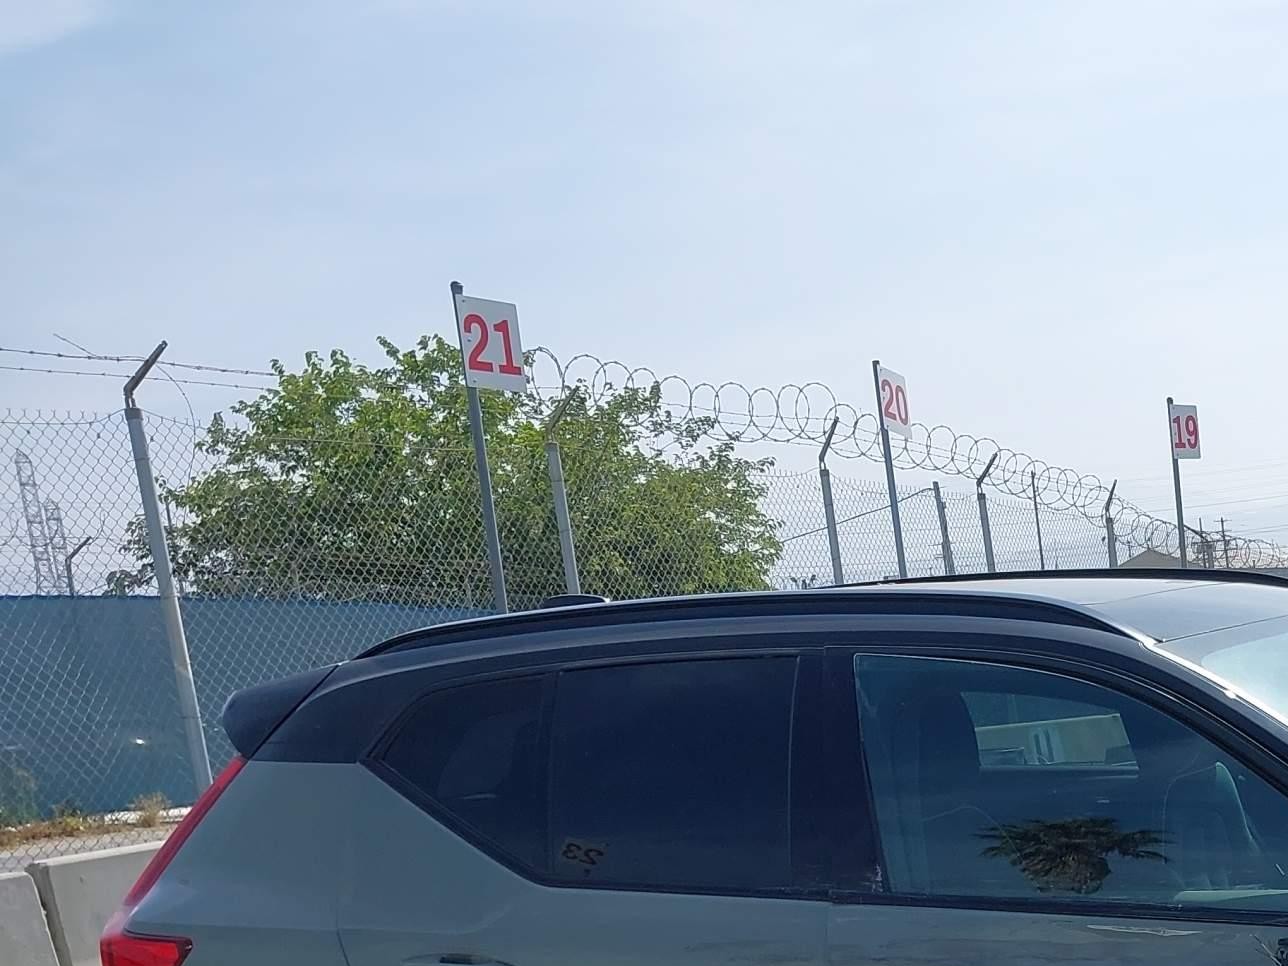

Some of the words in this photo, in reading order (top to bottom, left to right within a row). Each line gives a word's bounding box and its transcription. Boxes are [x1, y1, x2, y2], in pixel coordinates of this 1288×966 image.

[463, 313, 522, 376] 21
[881, 379, 908, 425] 20
[1172, 415, 1198, 449] 19
